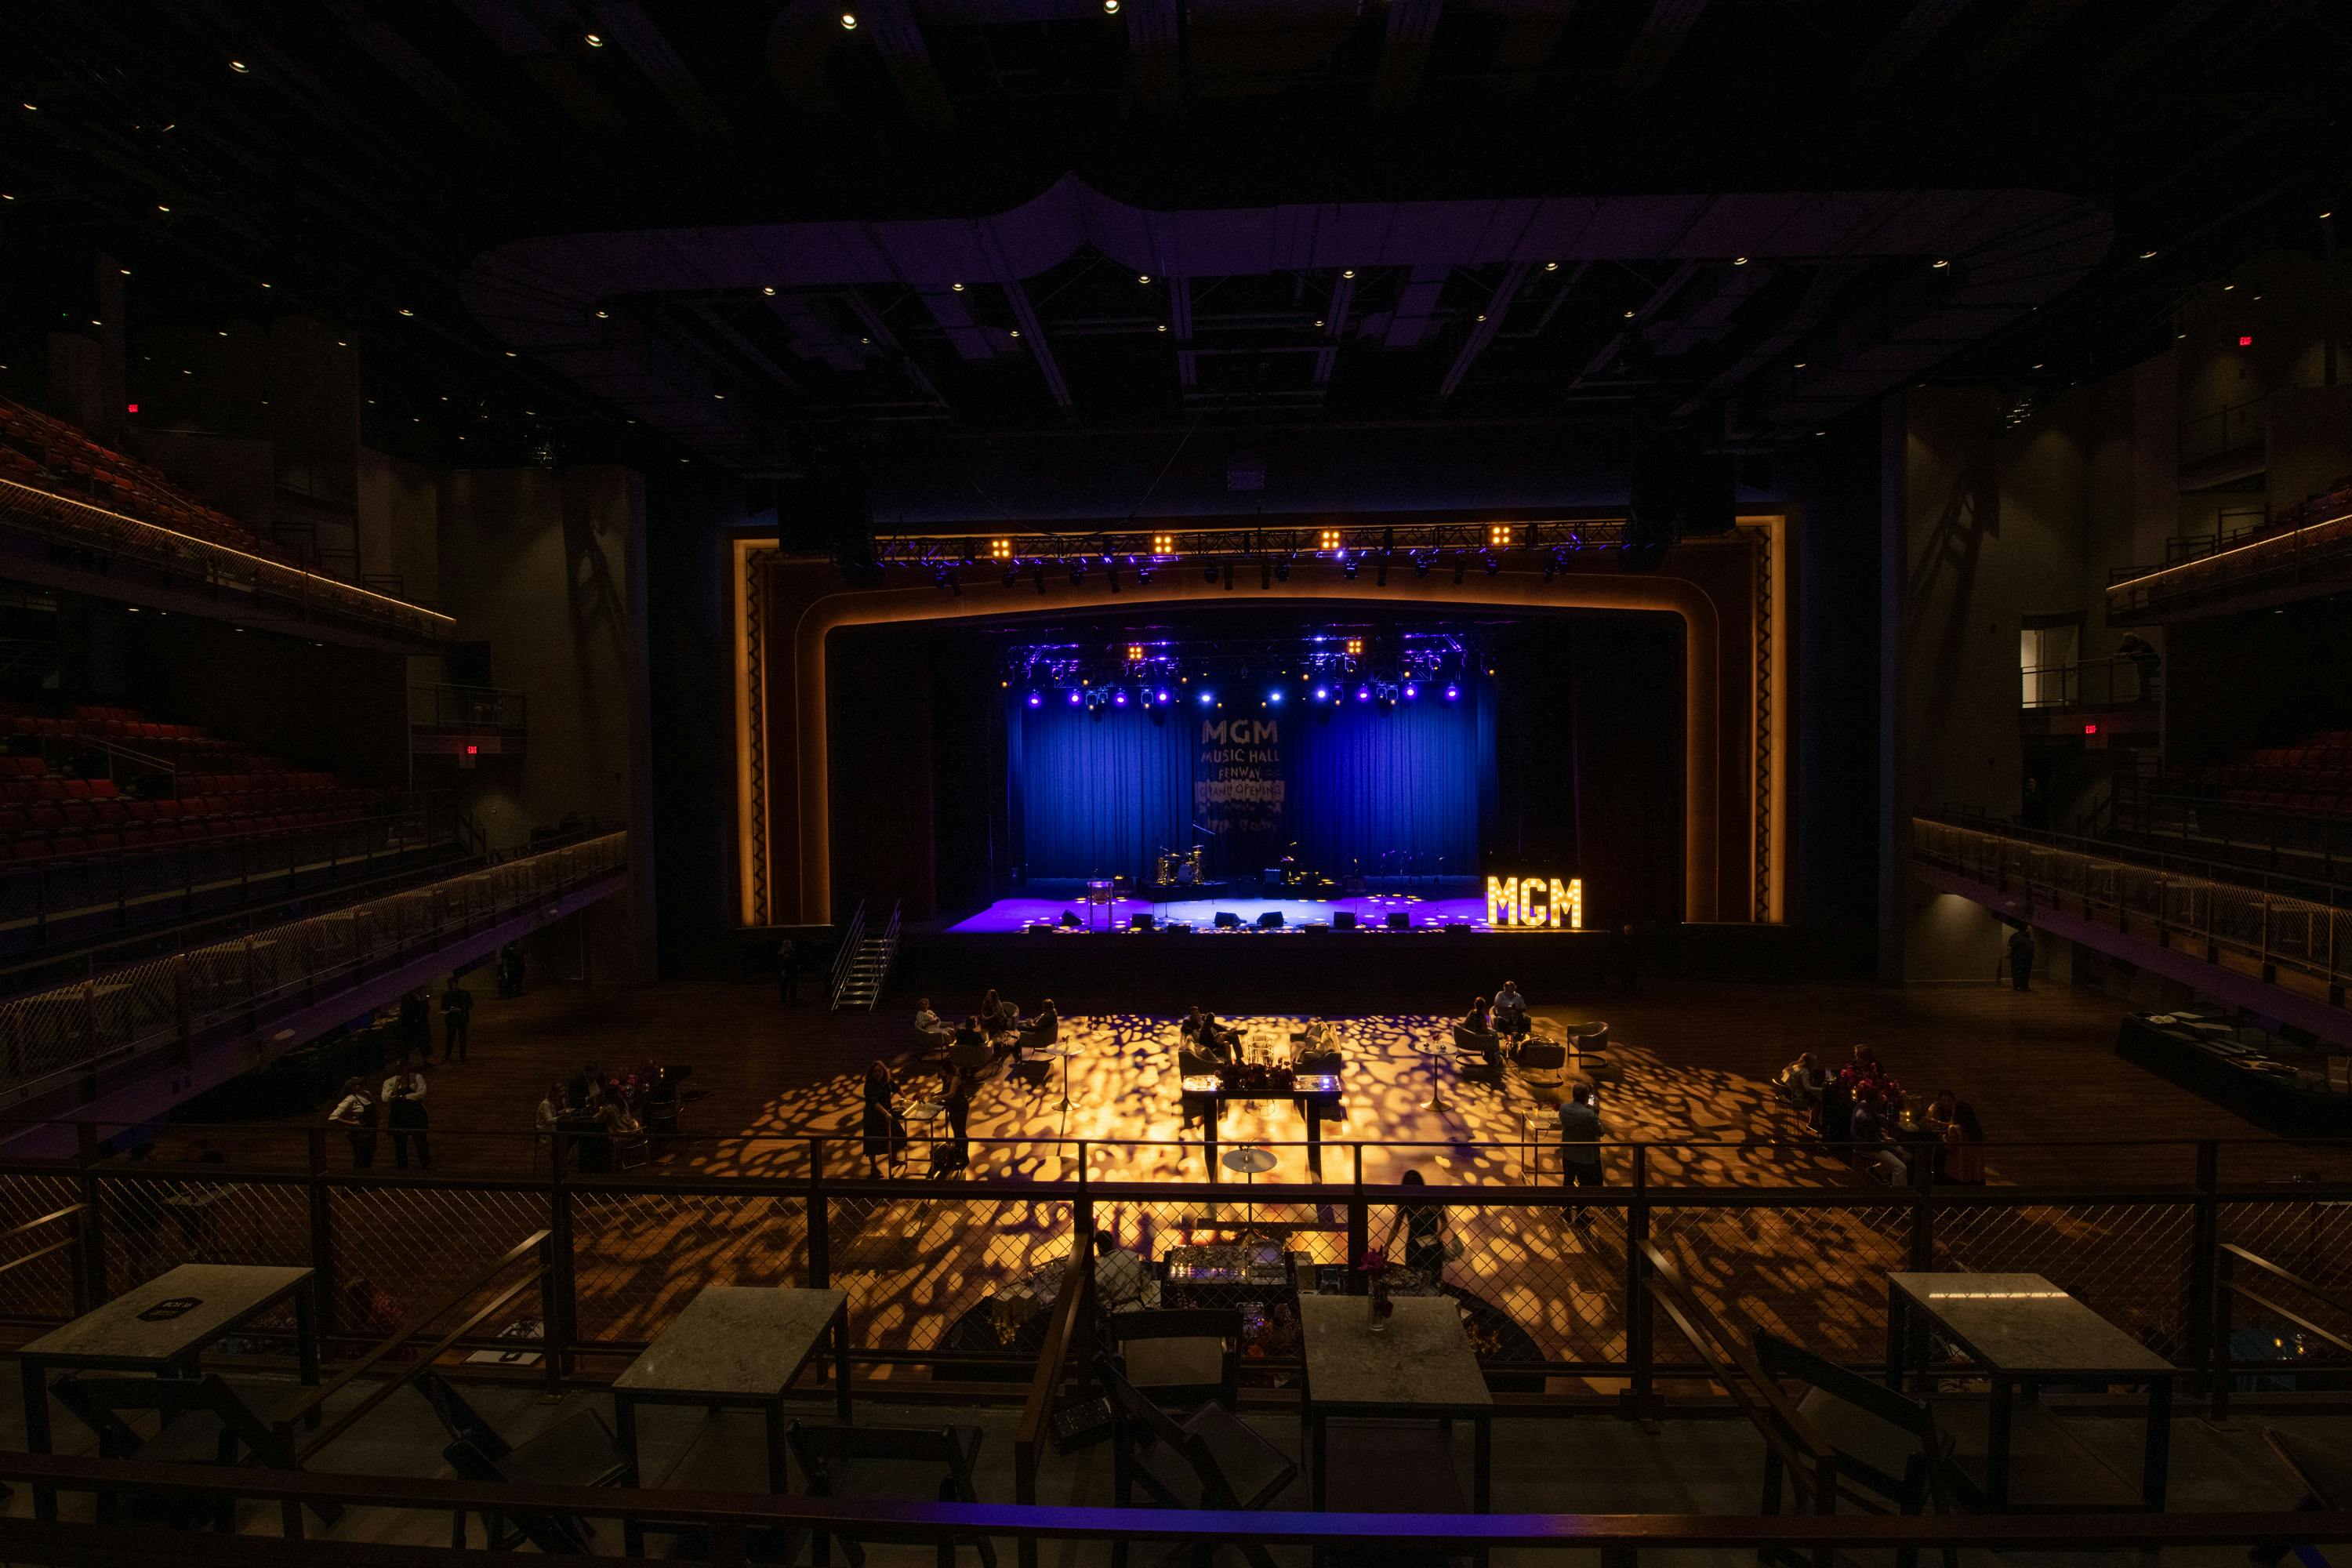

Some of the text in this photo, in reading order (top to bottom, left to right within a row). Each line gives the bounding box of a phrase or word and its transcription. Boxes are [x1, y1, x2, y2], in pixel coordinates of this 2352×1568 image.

[1201, 719, 1279, 745] MGM
[2085, 725, 2096, 734] EXIT
[1200, 749, 1280, 764] MUSIC HALL
[1218, 767, 1261, 781] FENWAY
[1236, 783, 1281, 797] OPENING
[1488, 877, 1581, 927] MGM
